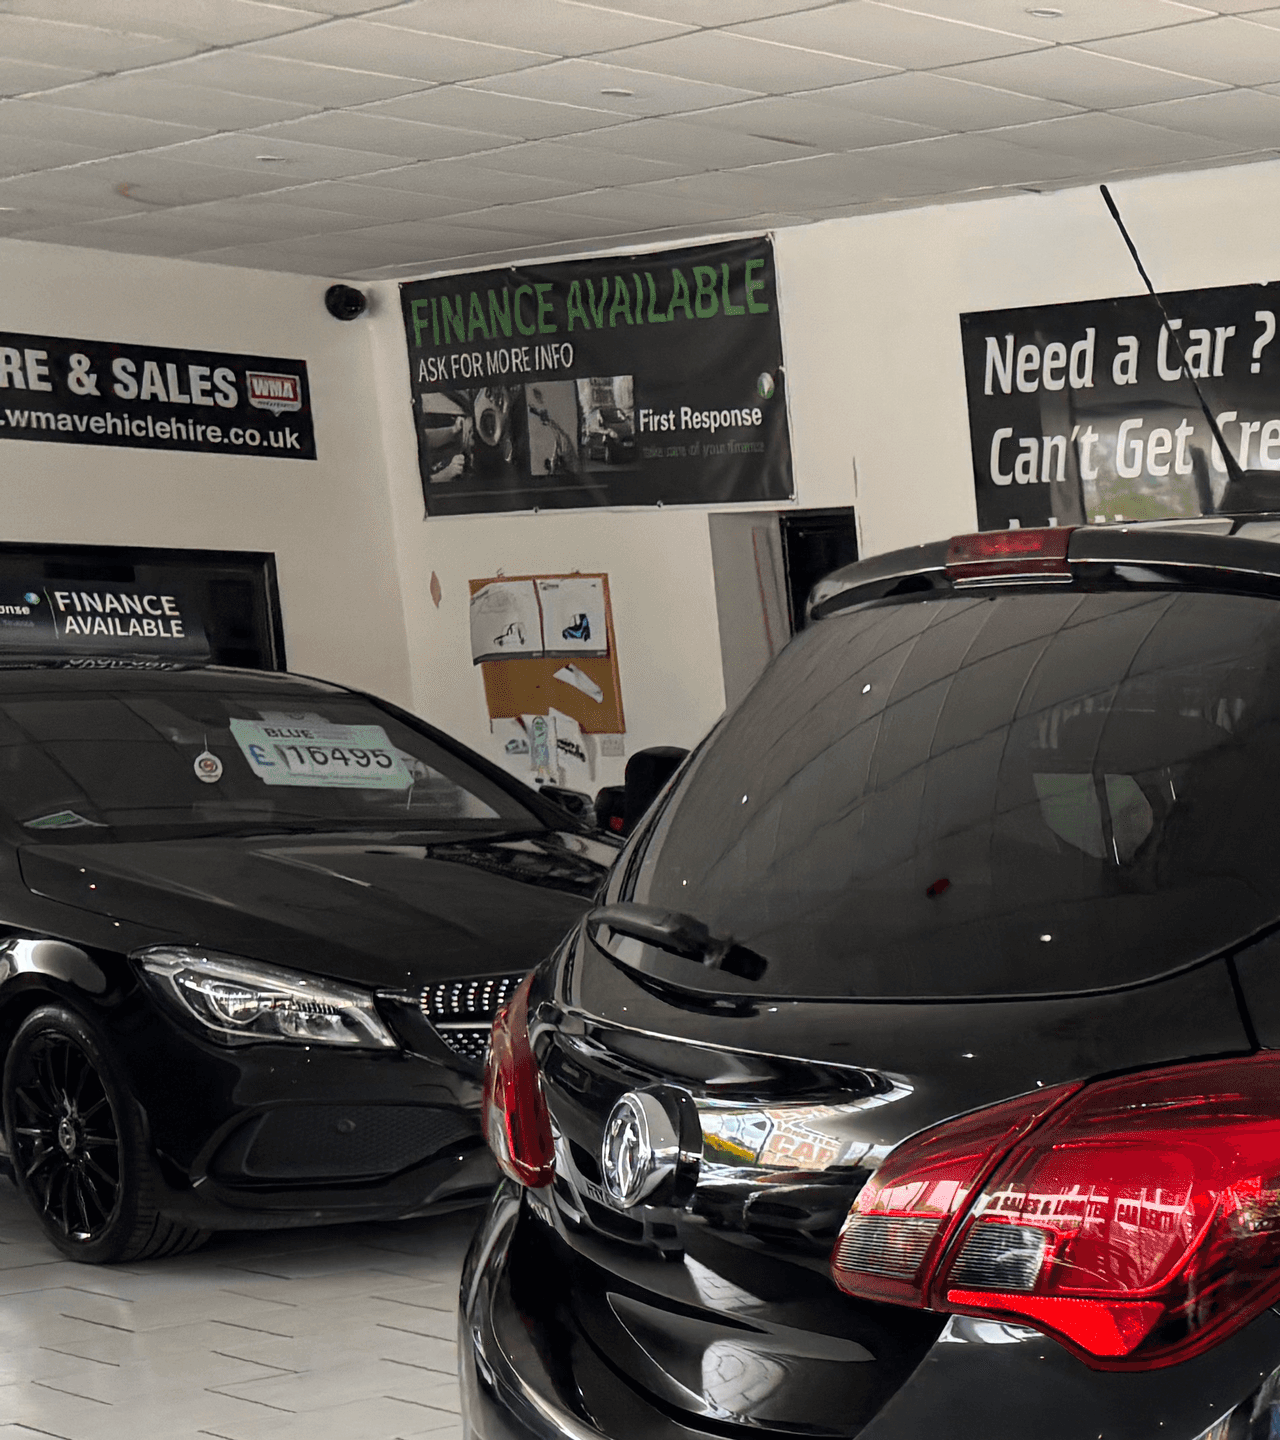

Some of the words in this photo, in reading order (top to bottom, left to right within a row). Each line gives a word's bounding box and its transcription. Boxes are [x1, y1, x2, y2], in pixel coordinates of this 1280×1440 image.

[411, 283, 556, 347] FINANCE
[567, 259, 769, 332] AVAILABLE
[418, 357, 449, 383] ASK
[451, 352, 484, 379] FOR
[486, 346, 530, 375] MORE
[535, 342, 574, 371] INFO
[984, 327, 1096, 396] Need
[1112, 335, 1140, 386] a
[1157, 318, 1236, 382] Car
[1250, 310, 1276, 374] ?
[0, 347, 52, 392] RE
[67, 353, 101, 396] &
[112, 357, 238, 409] SALES
[252, 378, 294, 399] WMA
[639, 409, 676, 432] First
[680, 406, 763, 433] Response
[990, 425, 1099, 486] Can't
[1116, 418, 1194, 479] Get
[54, 591, 181, 616] FINANCE
[65, 615, 185, 638] AVAILABLE
[263, 727, 315, 739] BLUE
